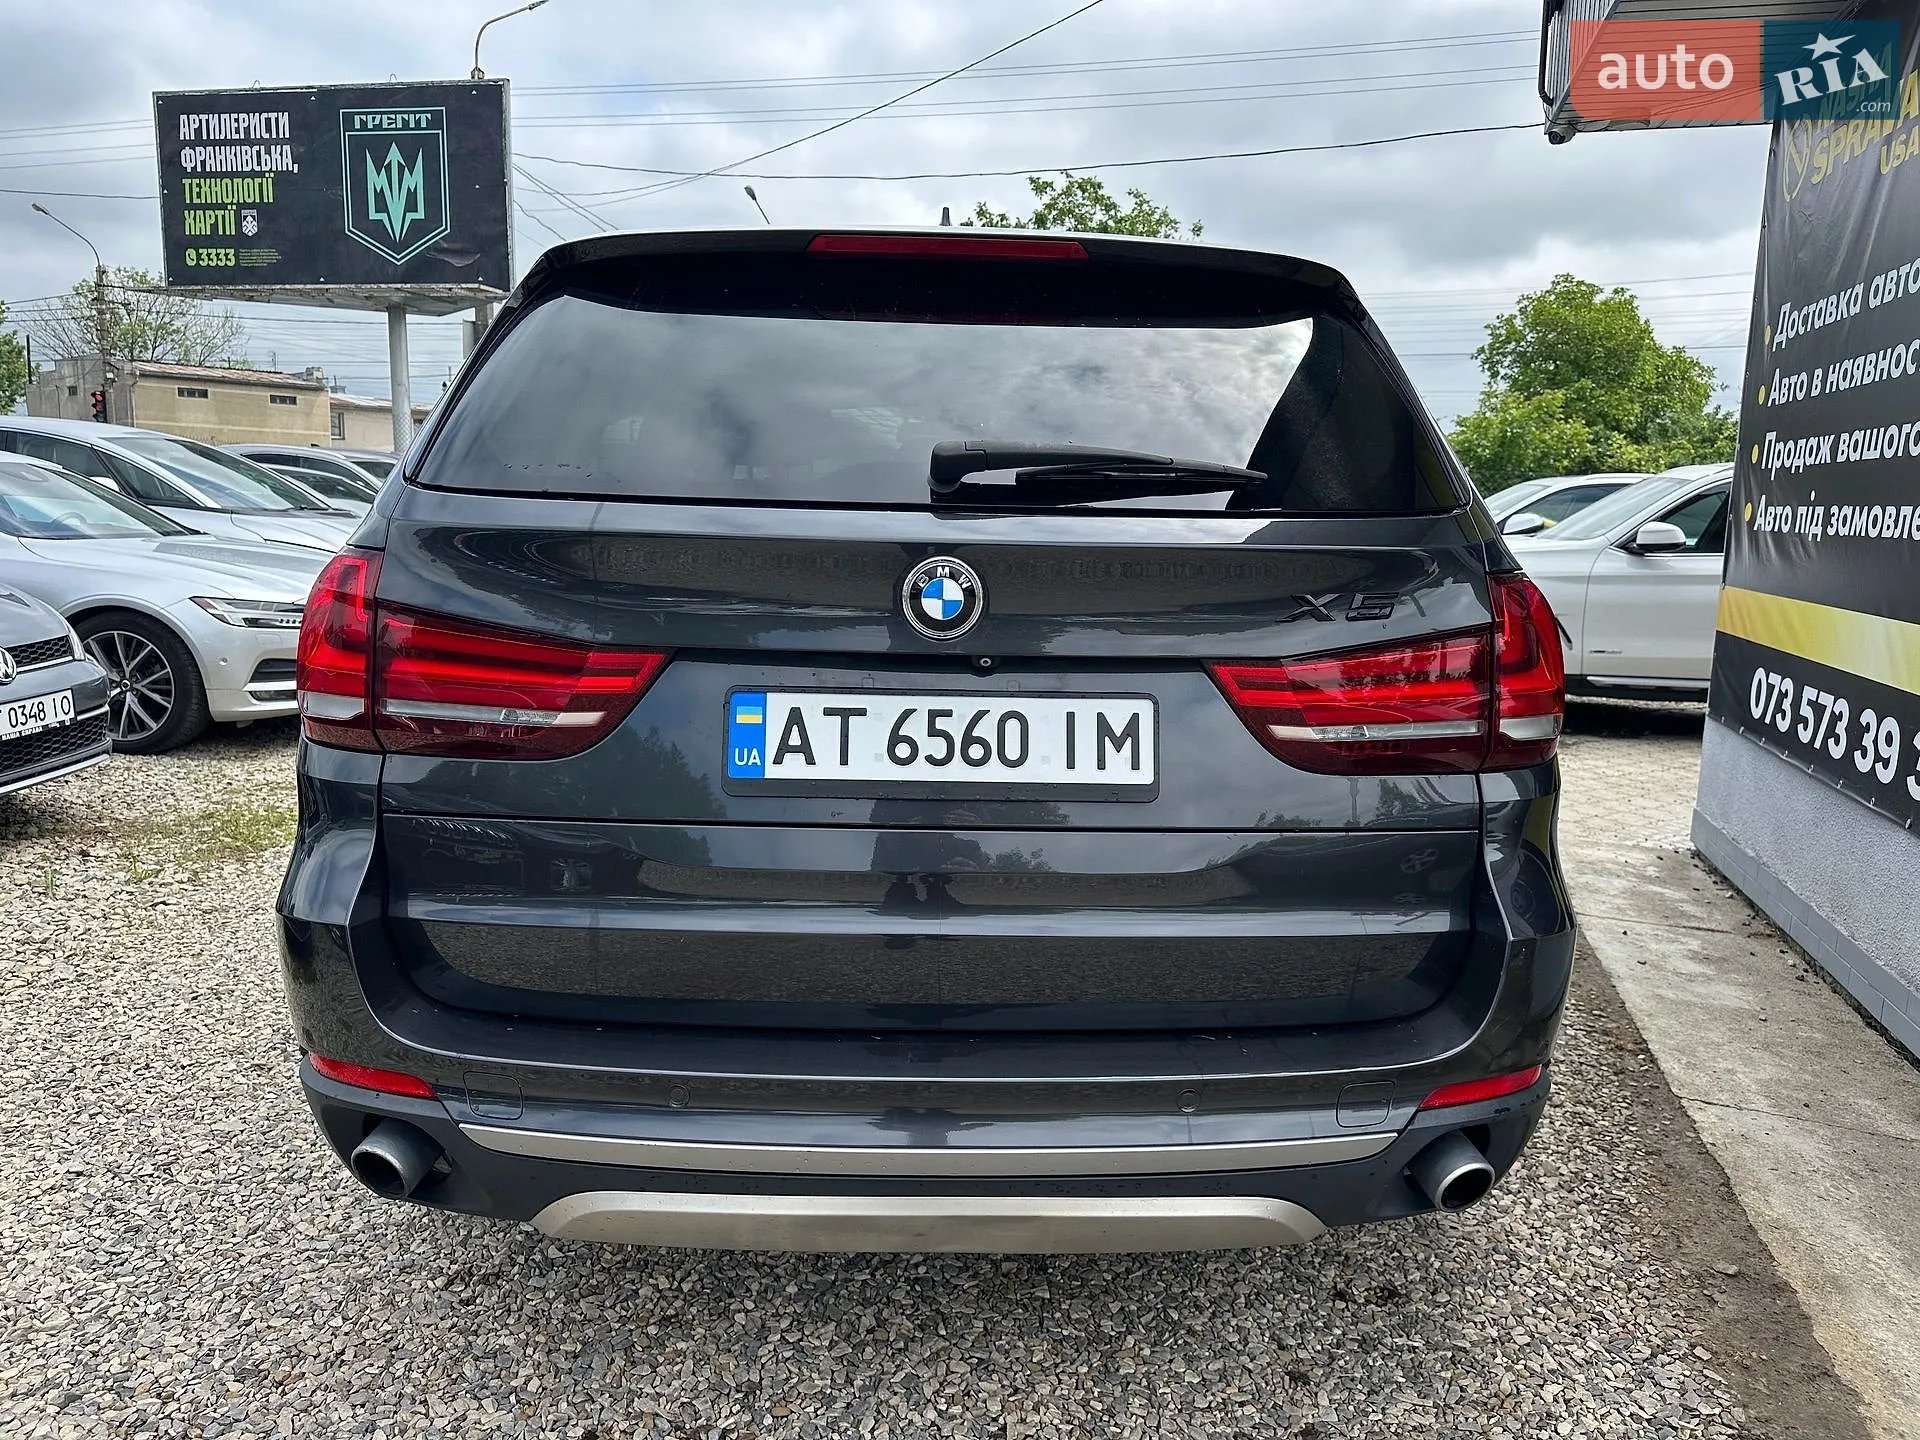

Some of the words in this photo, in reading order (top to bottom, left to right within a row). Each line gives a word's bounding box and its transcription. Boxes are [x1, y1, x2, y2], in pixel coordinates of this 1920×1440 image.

[179, 112, 290, 140] АРТИЛЕРИСТИ
[180, 144, 299, 174] ФРАНКІВСЬКА,
[1879, 125, 1920, 175] USA
[182, 172, 274, 204] ТЕХНОЛОГІЇ
[184, 204, 236, 236] ХАРТІЇ
[198, 248, 236, 267] 3333
[1772, 281, 1864, 352] Доставка
[1868, 257, 1920, 309] авто
[1767, 368, 1808, 407] Авто
[1810, 371, 1822, 397] в
[1825, 338, 1920, 395] наявнос
[1761, 431, 1836, 481] Продаж
[1836, 420, 1920, 463] вашого
[1753, 494, 1793, 533] Авто
[1795, 489, 1824, 542] під
[916, 566, 971, 588] BMW
[1275, 591, 1400, 622] X5
[8, 701, 46, 728] 0348
[1749, 667, 1794, 733] 073
[1797, 685, 1850, 759] 573
[1854, 708, 1901, 784] 39
[772, 706, 867, 766] AT
[886, 708, 1029, 769] 6560
[1065, 711, 1140, 771] IM
[734, 748, 761, 766] UA
